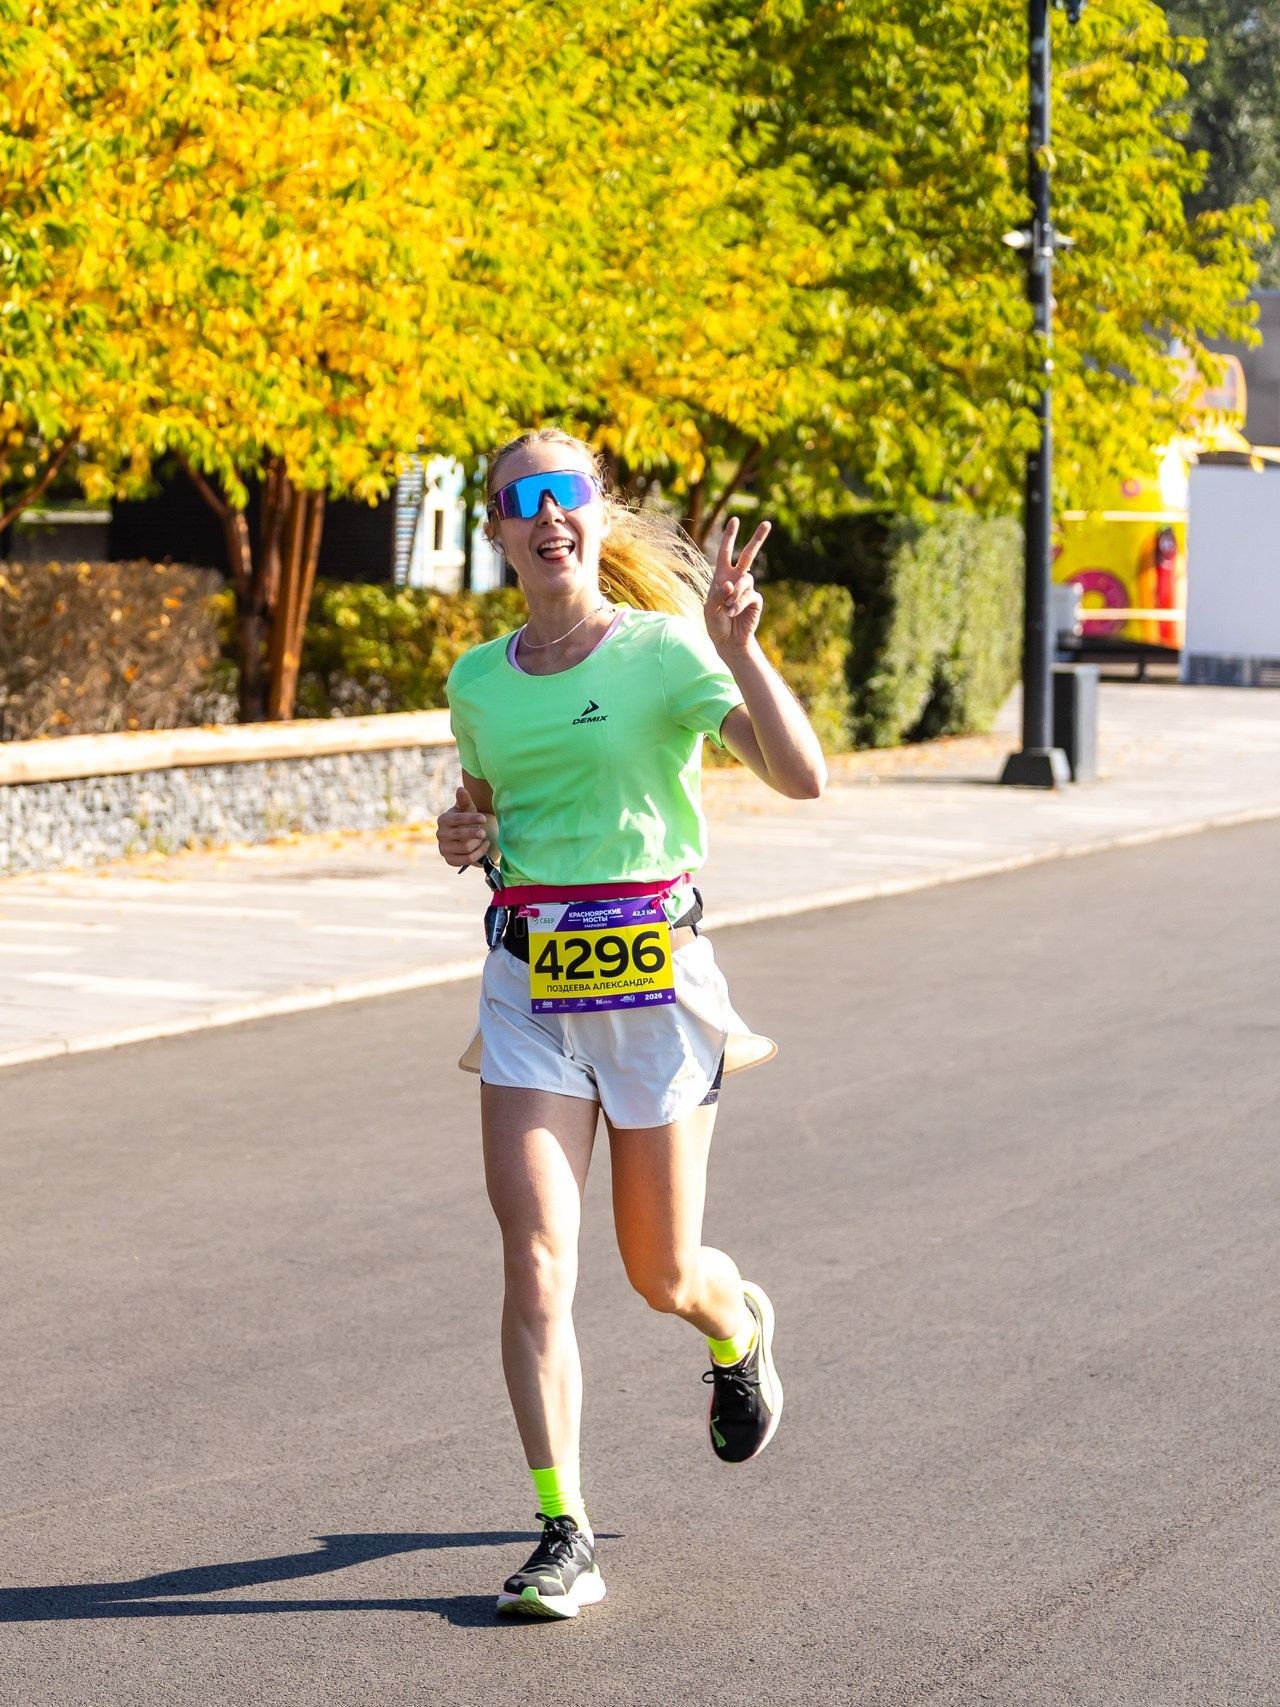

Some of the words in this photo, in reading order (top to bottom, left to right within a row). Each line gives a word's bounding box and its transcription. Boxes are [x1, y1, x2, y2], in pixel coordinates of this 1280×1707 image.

[572, 715, 608, 725] DEMIX
[568, 908, 622, 919] КРАСНОЯРСКИЕ
[534, 930, 666, 981] 4296
[546, 983, 591, 993] ПОЗДЕЕВА
[592, 977, 655, 991] АЛЕКСАНДРА
[644, 992, 663, 1001] 2026
